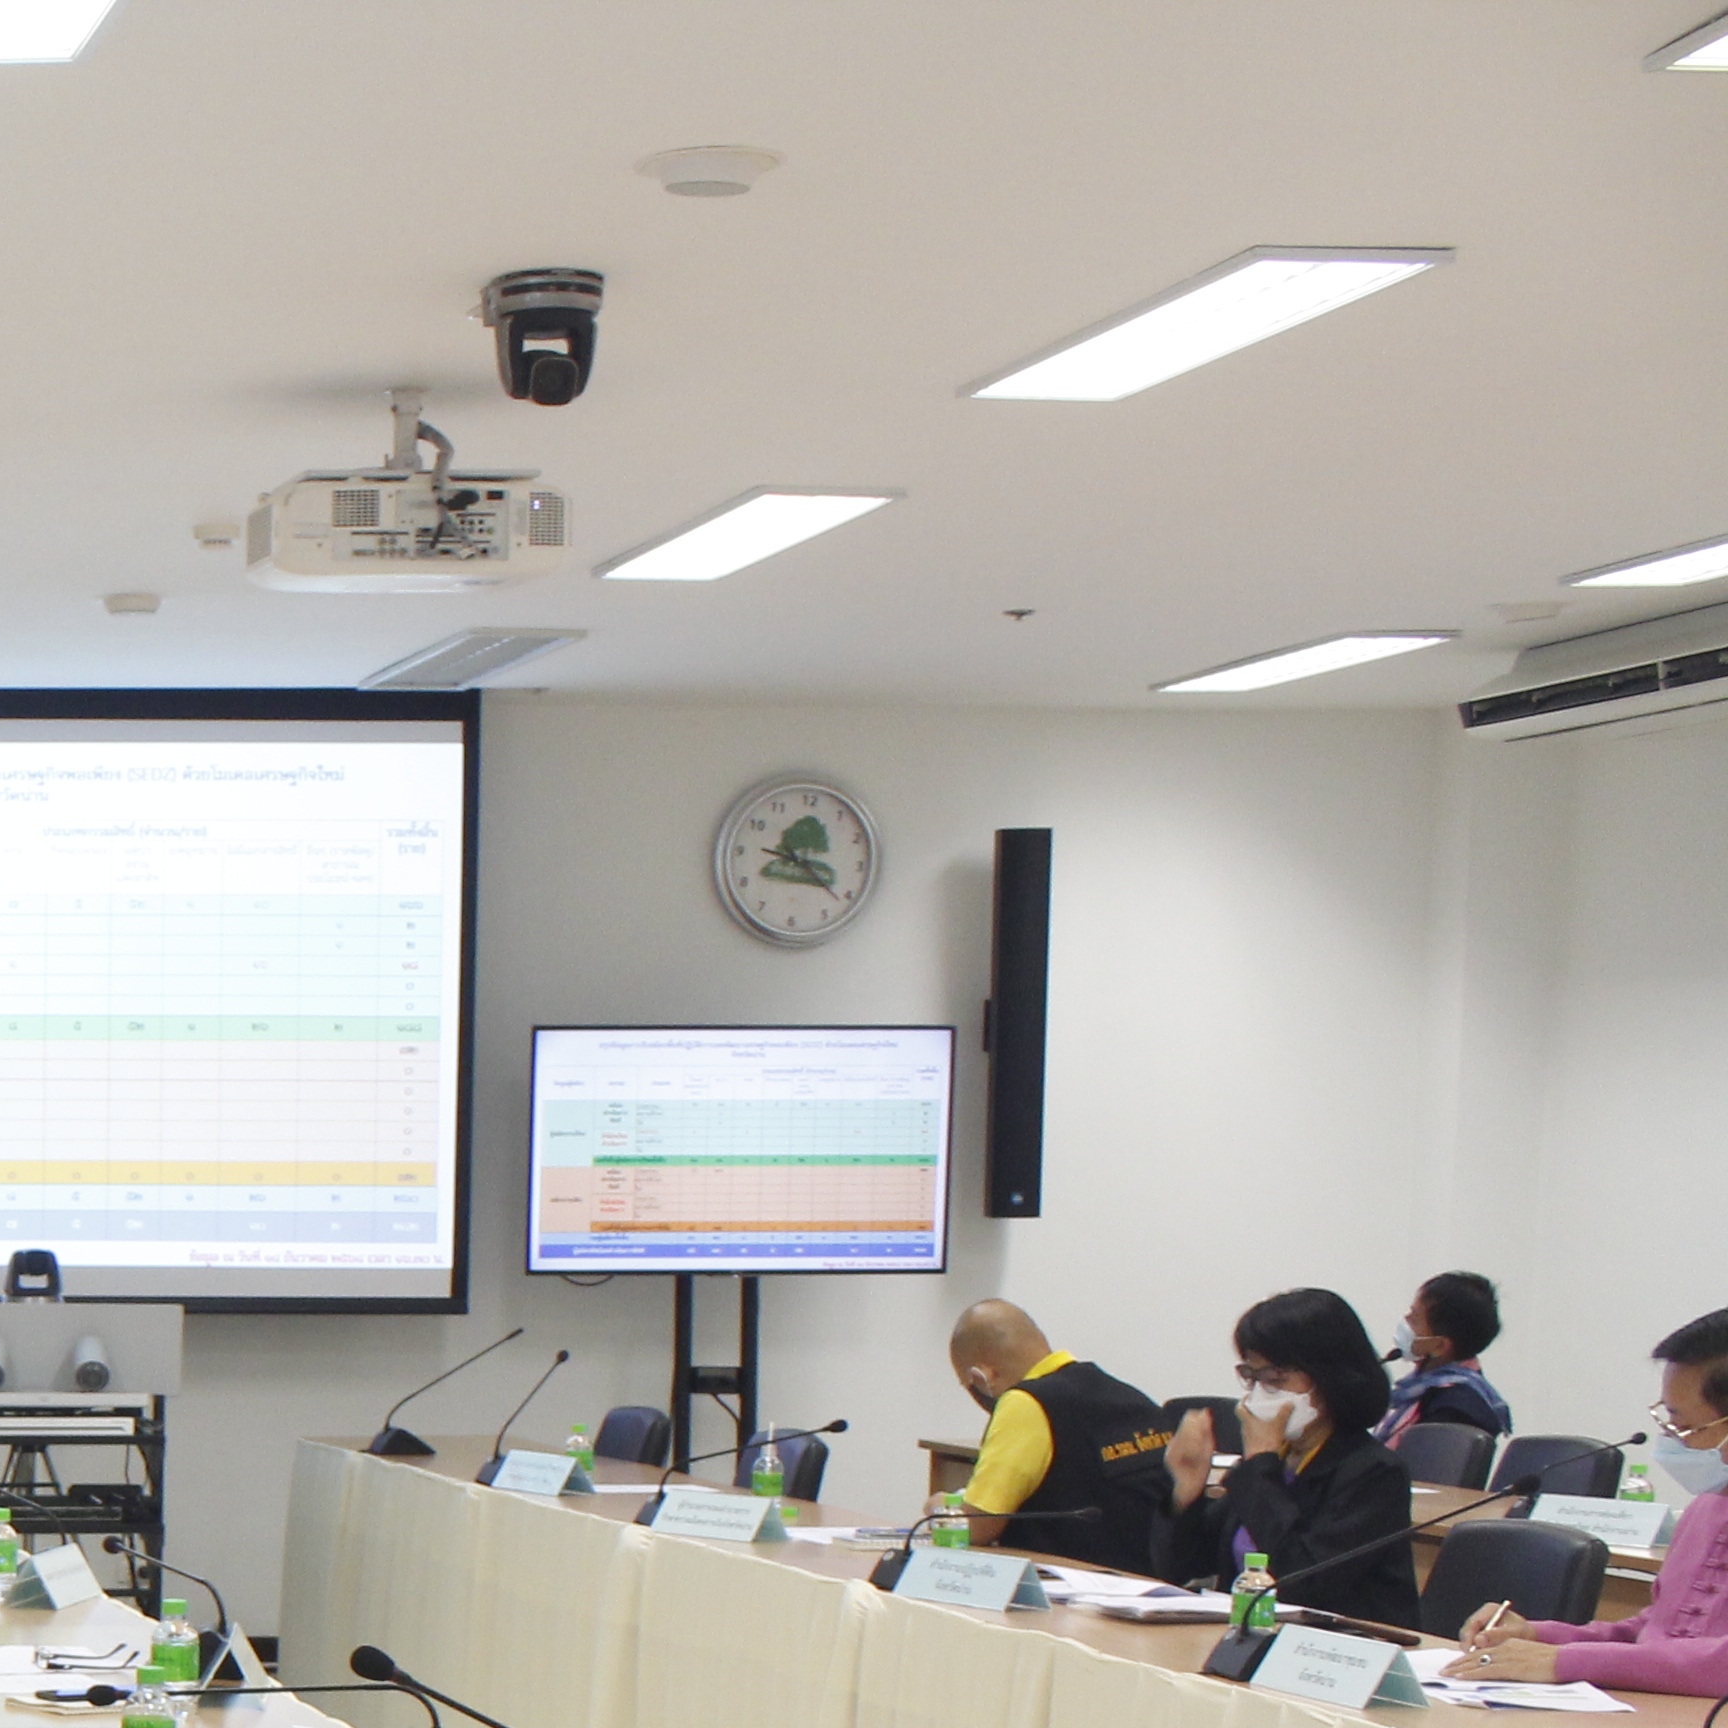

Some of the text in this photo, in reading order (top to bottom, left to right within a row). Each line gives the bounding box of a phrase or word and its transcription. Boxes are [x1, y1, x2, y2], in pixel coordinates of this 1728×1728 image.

[802, 795, 817, 807] 12
[771, 802, 786, 813] 11
[837, 810, 844, 821] 1
[750, 819, 766, 831] 10
[852, 832, 861, 844] 2
[736, 846, 744, 856] 9
[856, 861, 863, 872] 3
[757, 901, 766, 912] 7
[787, 916, 795, 927] 6
